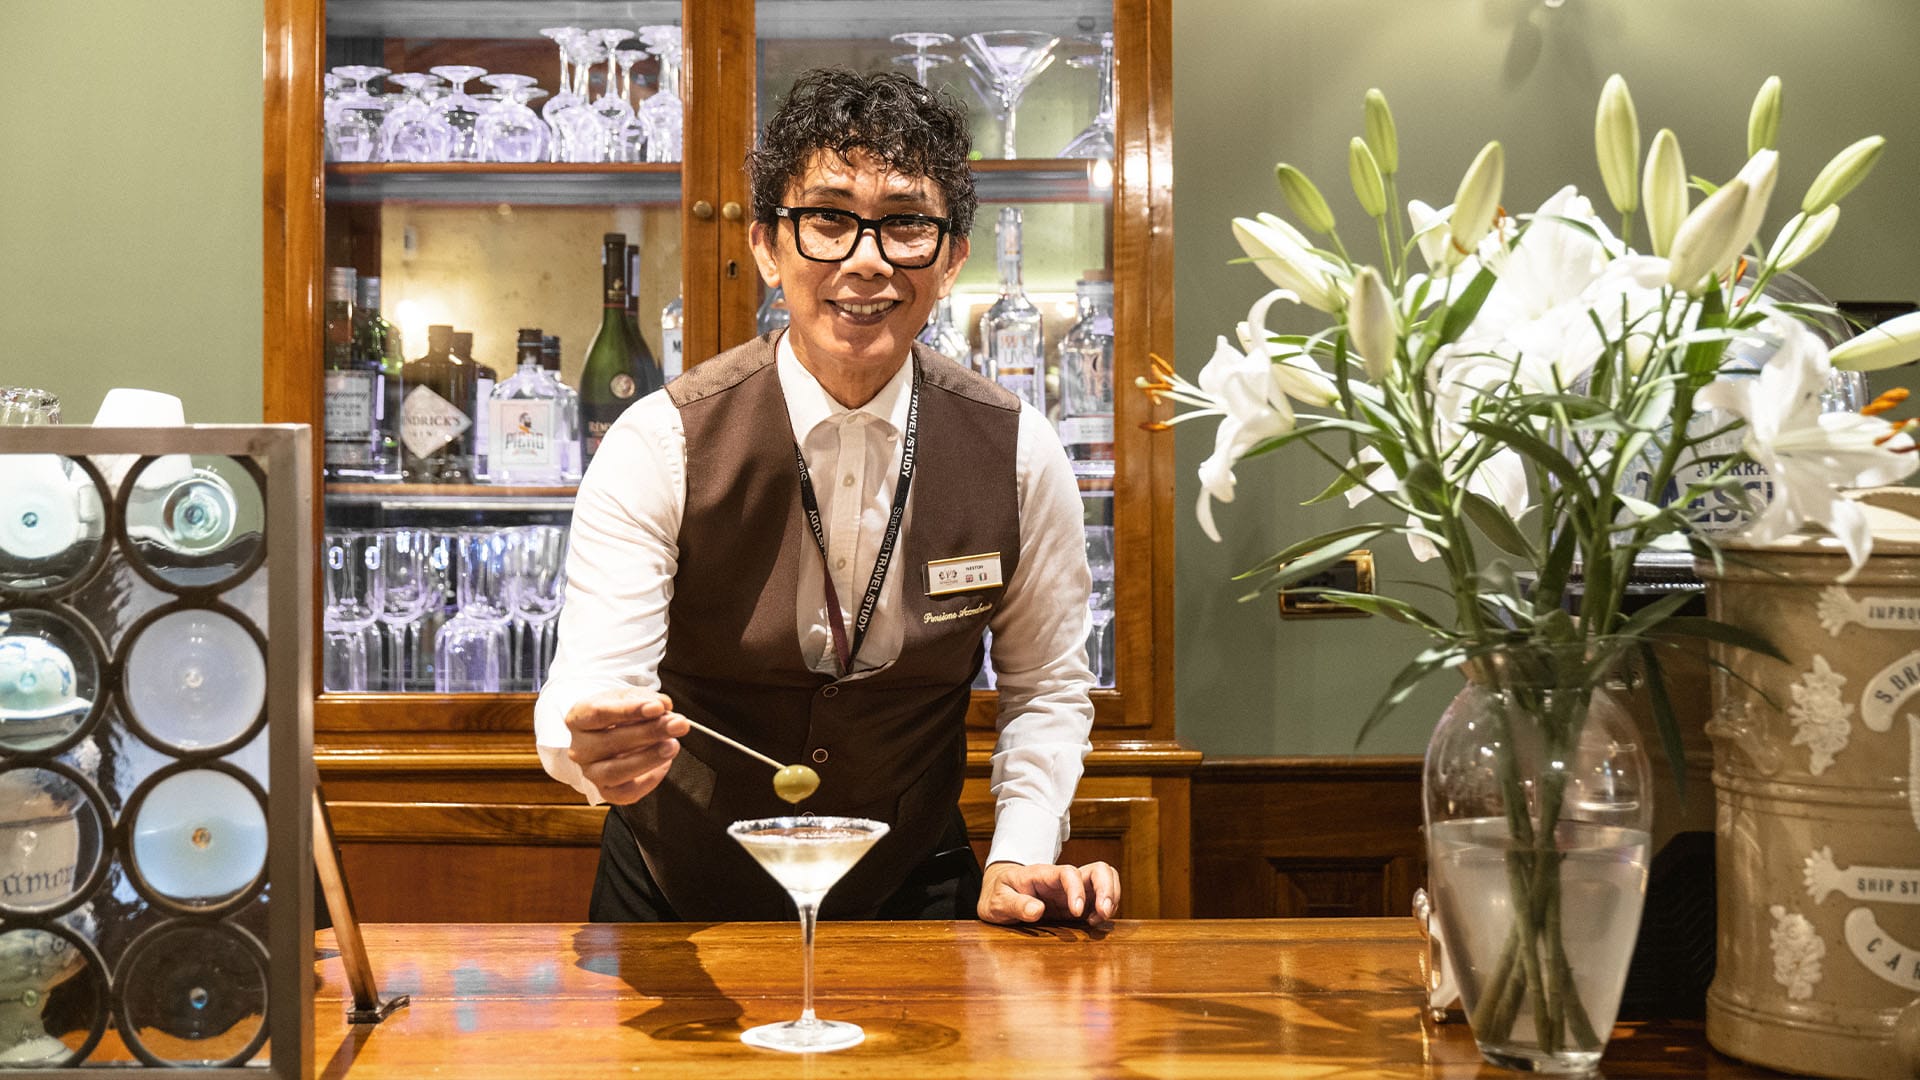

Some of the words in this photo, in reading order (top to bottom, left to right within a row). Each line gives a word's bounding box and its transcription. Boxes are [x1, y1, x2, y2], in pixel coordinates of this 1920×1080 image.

[901, 393, 919, 478] TRAVEL/STUDY
[883, 506, 903, 551] Stanford
[857, 551, 890, 632] TRAVEL/STUDY
[1857, 877, 1895, 893] SHIP
